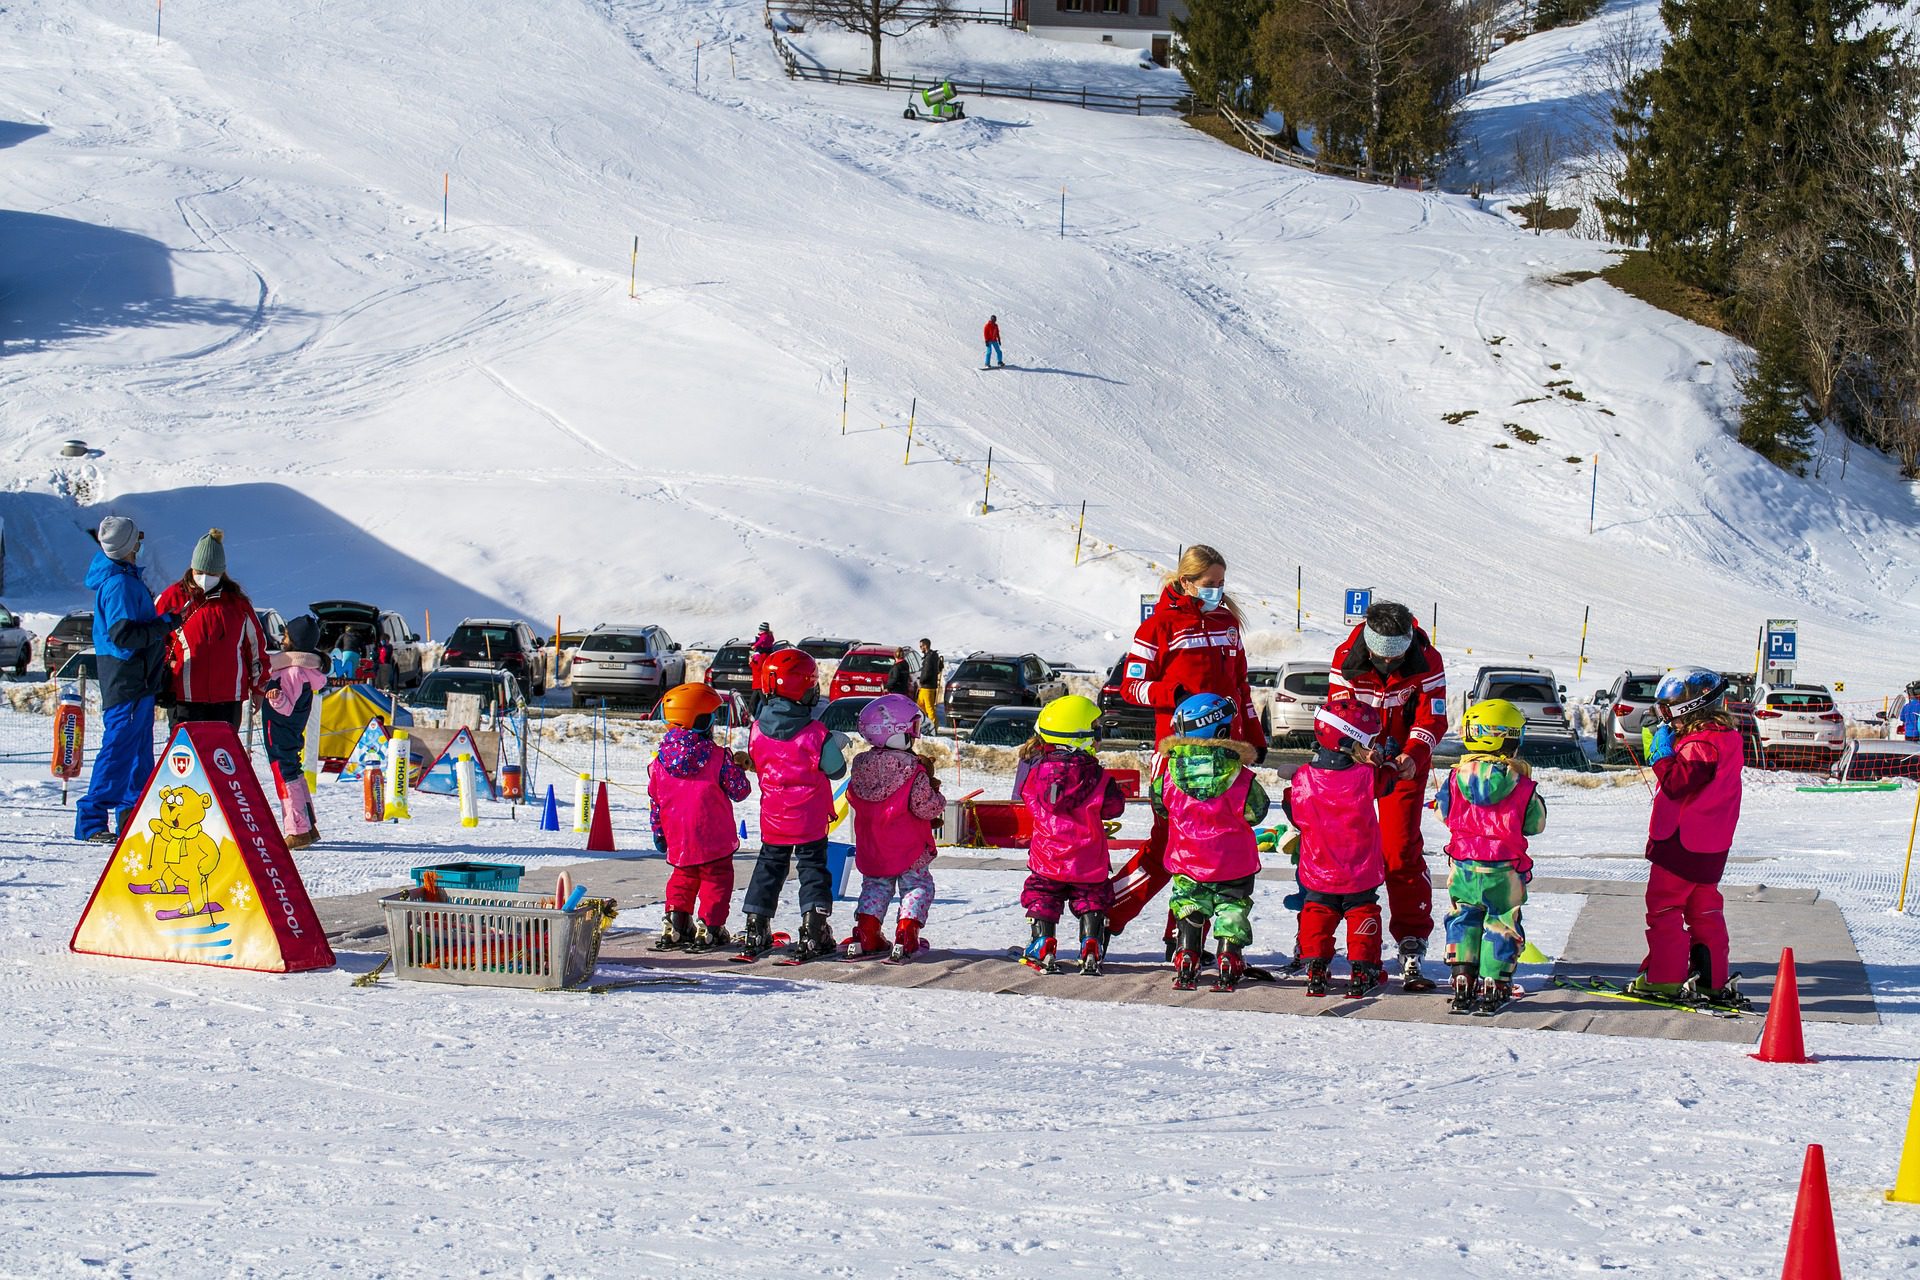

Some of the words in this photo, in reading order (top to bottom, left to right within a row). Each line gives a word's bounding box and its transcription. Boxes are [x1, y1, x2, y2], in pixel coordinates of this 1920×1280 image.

[1354, 592, 1362, 604] P
[1144, 606, 1153, 619] P
[1771, 635, 1783, 652] P
[1195, 708, 1226, 728] uvex
[64, 714, 76, 766] ovomaltine
[1342, 724, 1363, 740] SMITH
[397, 759, 406, 796] THOMY
[228, 780, 259, 833] SWISS
[252, 837, 272, 863] SKI
[266, 867, 304, 939] SCHOOL
